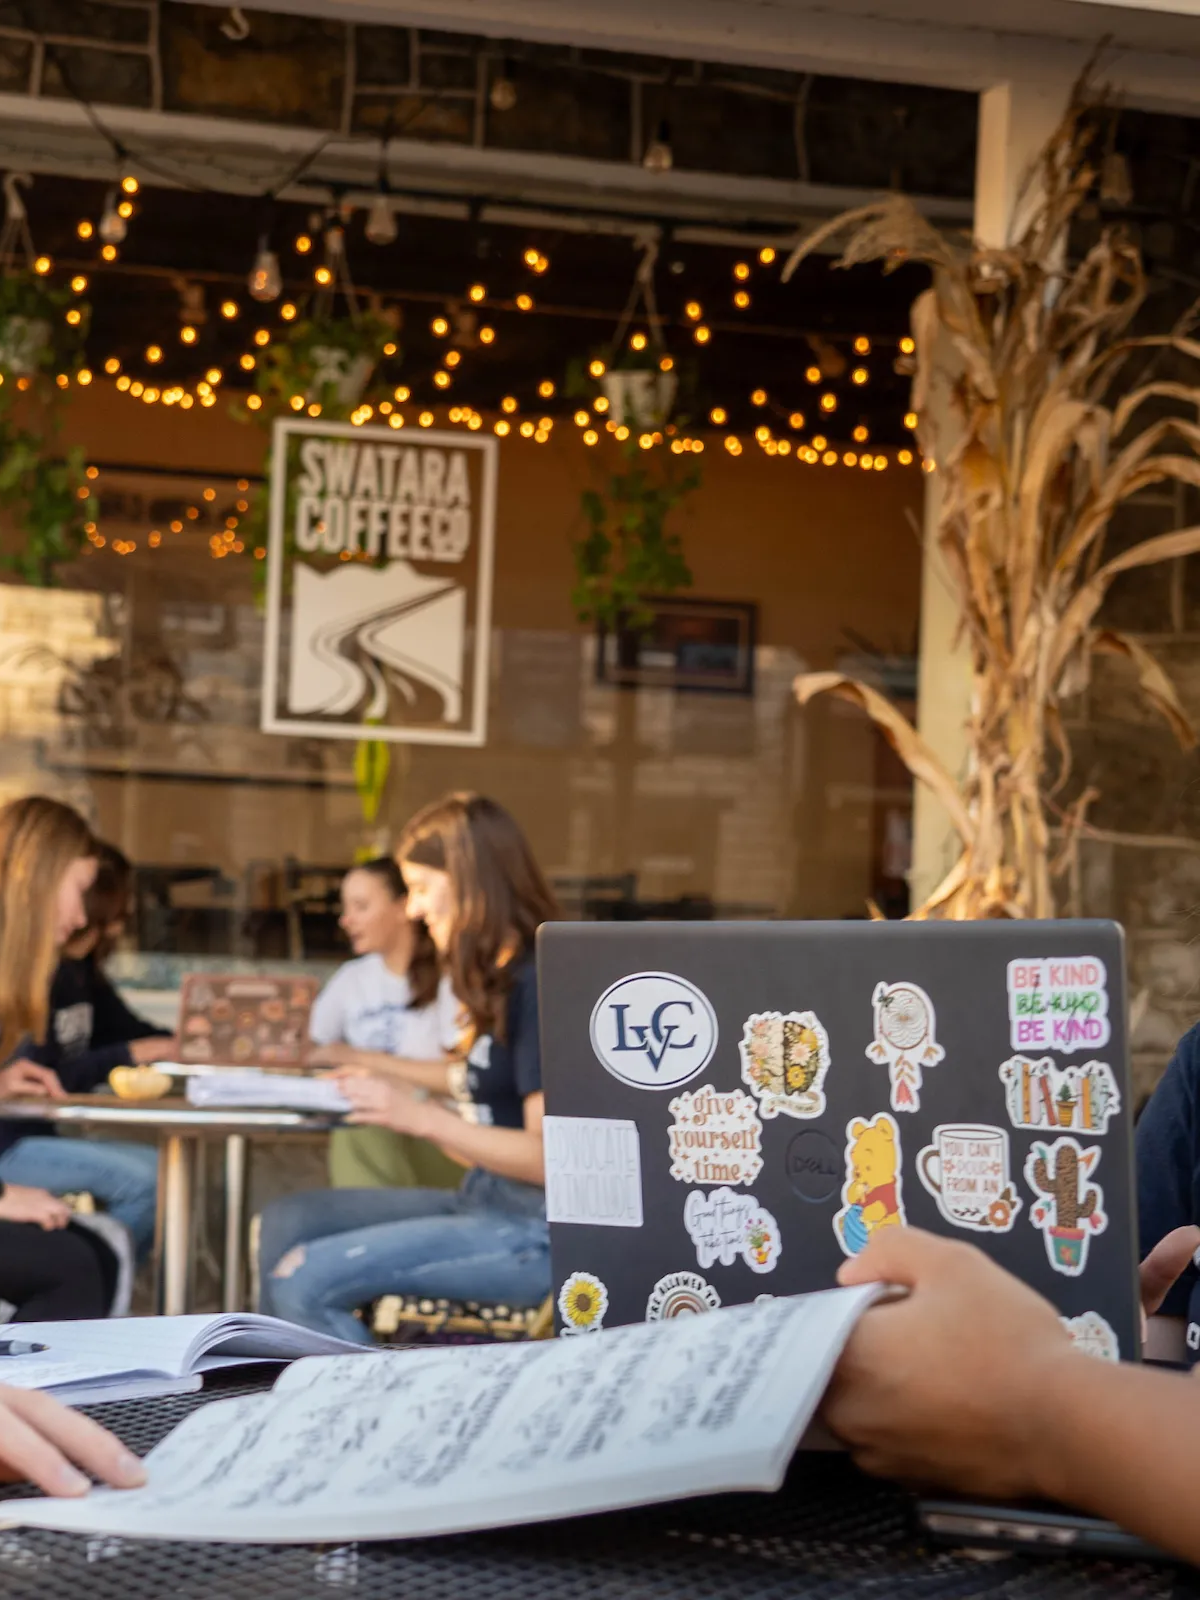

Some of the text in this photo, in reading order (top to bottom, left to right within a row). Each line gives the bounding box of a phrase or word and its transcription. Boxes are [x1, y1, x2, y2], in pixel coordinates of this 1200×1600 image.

[299, 438, 470, 509] SWATARA
[1013, 964, 1099, 988] BE KIND
[608, 1001, 698, 1073] LVC
[1018, 1018, 1103, 1042] BE KIND
[693, 1090, 735, 1126] give
[673, 1124, 757, 1155] yourself
[695, 1155, 741, 1181] time
[793, 1155, 837, 1175] DELL
[947, 1177, 977, 1193] FROM
[705, 1289, 717, 1307] TO
